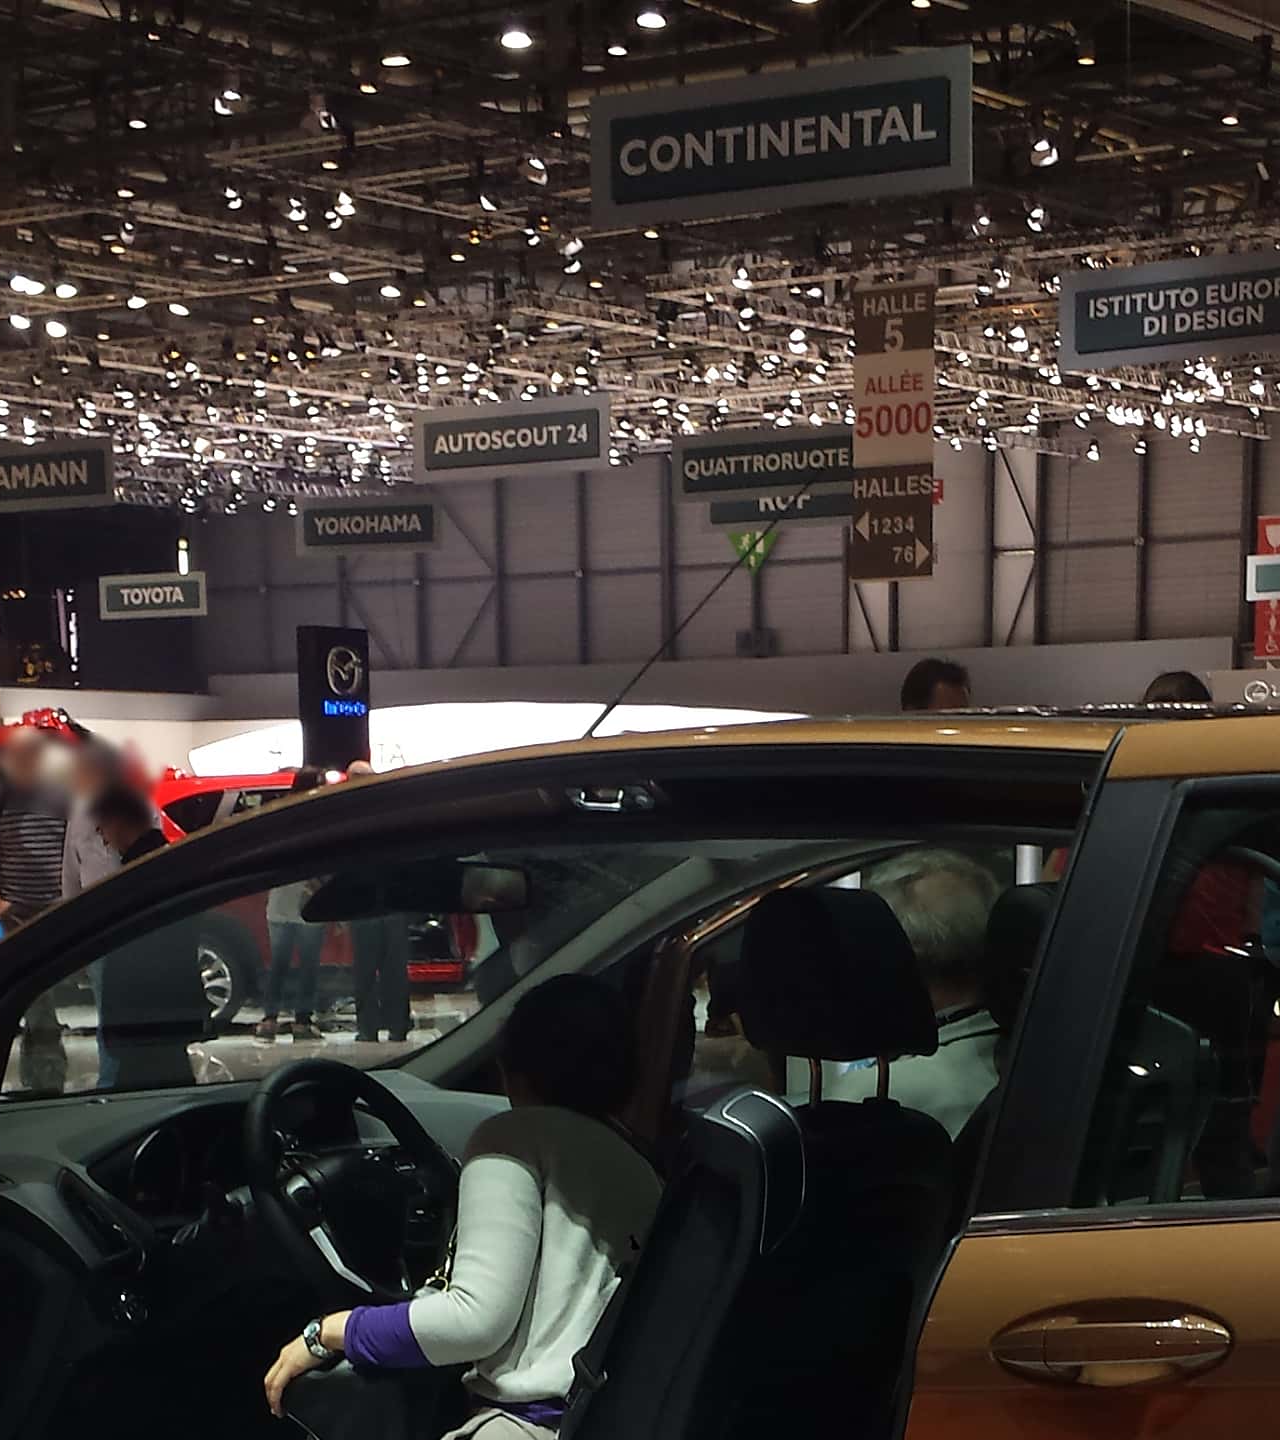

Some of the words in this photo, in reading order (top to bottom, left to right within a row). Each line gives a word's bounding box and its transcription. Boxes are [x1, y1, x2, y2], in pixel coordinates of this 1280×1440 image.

[619, 102, 938, 177] CONTINENTAL
[862, 292, 928, 318] HALLE
[1088, 287, 1199, 319] ISTITUTO
[1142, 313, 1168, 338] DI
[1173, 303, 1265, 335] DESIGN
[883, 318, 905, 352] 5
[864, 369, 924, 396] ALLÉE
[854, 401, 933, 440] 5000
[433, 424, 562, 456] AUTOSCOUT
[566, 422, 589, 445] 24
[852, 476, 934, 499] HALLES
[314, 512, 422, 536] YOKOHAMA
[870, 515, 915, 536] 1234
[891, 545, 914, 566] 76
[119, 585, 185, 606] TOYOTA
